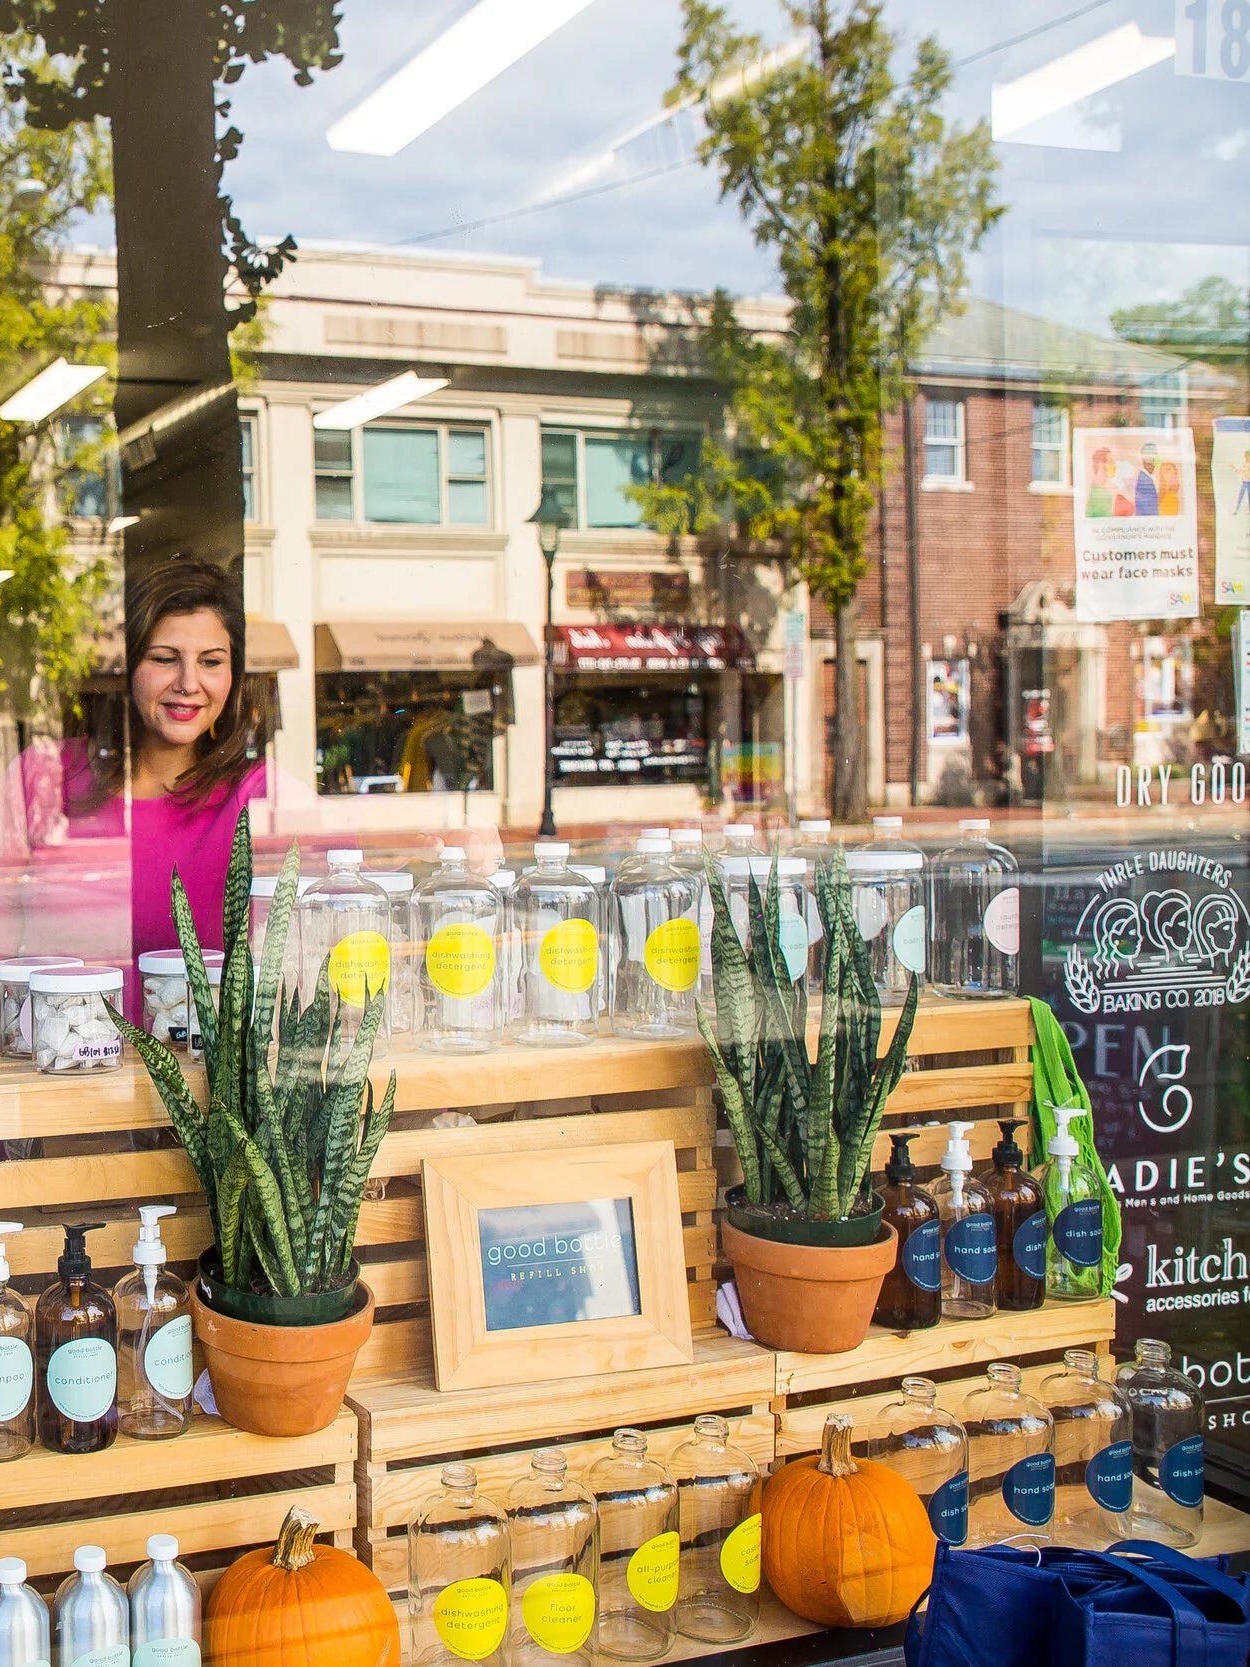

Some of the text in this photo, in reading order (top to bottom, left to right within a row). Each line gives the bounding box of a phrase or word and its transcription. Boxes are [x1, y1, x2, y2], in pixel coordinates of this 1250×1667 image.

[1083, 547, 1194, 562] Customers must
[1082, 564, 1193, 580] wear face masks
[1116, 761, 1247, 807] DRY GOO
[1095, 850, 1233, 894] THREE DAUGHTERS
[432, 951, 491, 962] dishwashing
[436, 962, 487, 971] detergent
[1103, 991, 1162, 1014] BAKING
[1194, 987, 1225, 1007] 2018
[1159, 1194, 1180, 1206] and
[1183, 1192, 1214, 1203] Home
[1217, 1189, 1250, 1201] Goods
[1066, 1230, 1087, 1238] dish
[488, 1232, 622, 1265] good bottle
[954, 1246, 980, 1254] hand
[1025, 1243, 1041, 1252] dish
[913, 1252, 934, 1262] hand
[510, 1268, 562, 1282] REFILL
[1146, 1289, 1239, 1312] accessories
[67, 1347, 85, 1355] good
[54, 1371, 113, 1385] conditioner
[1098, 1473, 1122, 1483] hand
[1173, 1468, 1193, 1478] dish
[1014, 1486, 1040, 1495] hand
[941, 1507, 960, 1518] dish
[441, 1604, 504, 1619] dishwashing
[447, 1617, 500, 1630] detergent
[541, 1615, 582, 1624] cleaner
[90, 1655, 106, 1664] good
